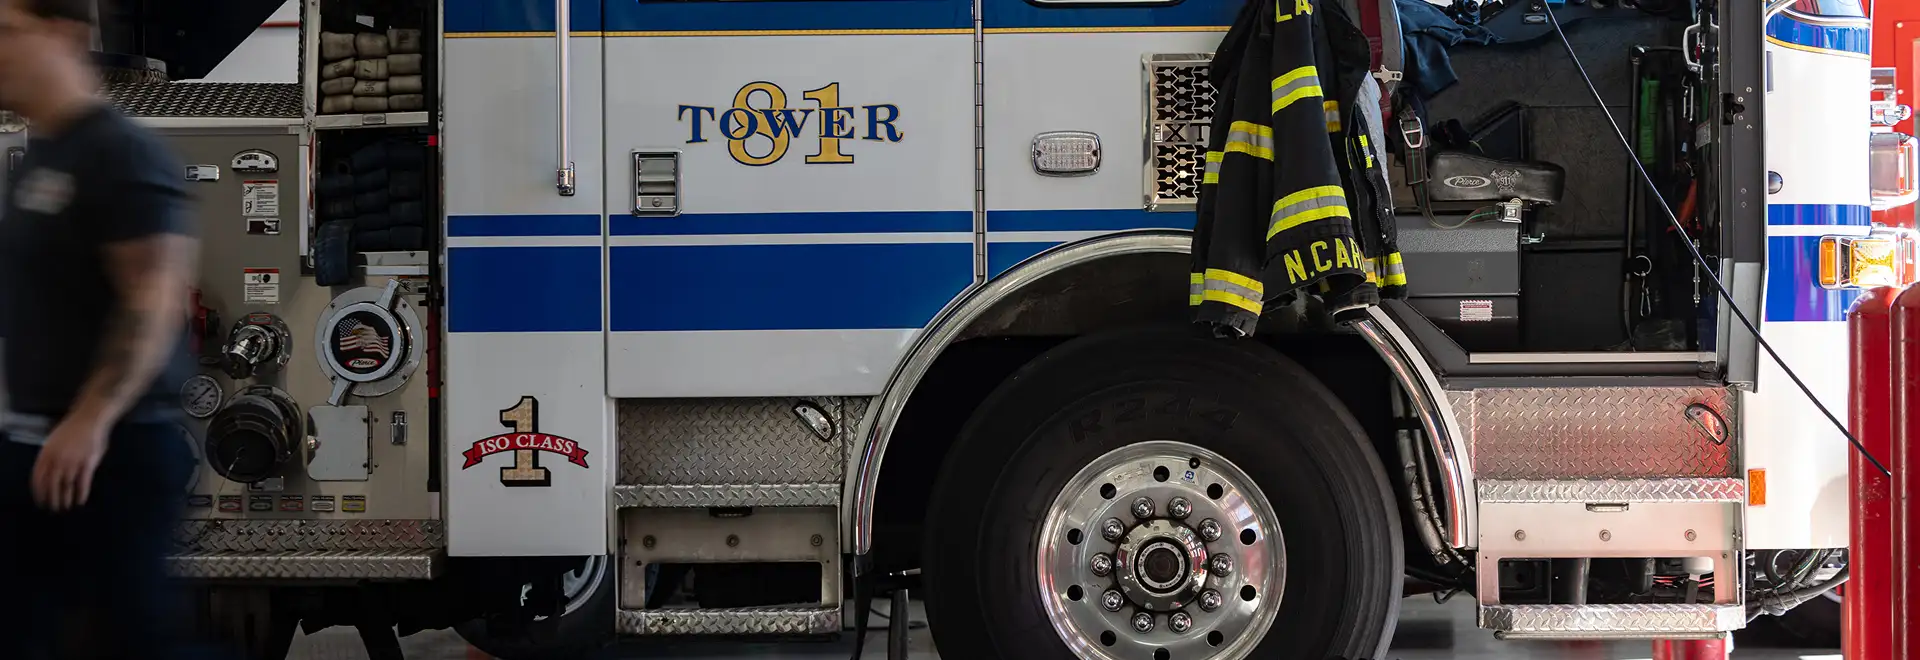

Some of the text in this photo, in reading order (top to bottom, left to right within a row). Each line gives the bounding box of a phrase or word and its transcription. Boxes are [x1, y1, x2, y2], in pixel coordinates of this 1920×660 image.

[677, 103, 904, 145] TOWER
[727, 81, 855, 166] 81
[1454, 176, 1511, 186] Pierce 911
[478, 434, 575, 455] ISO CLASS
[499, 395, 552, 487] 1
